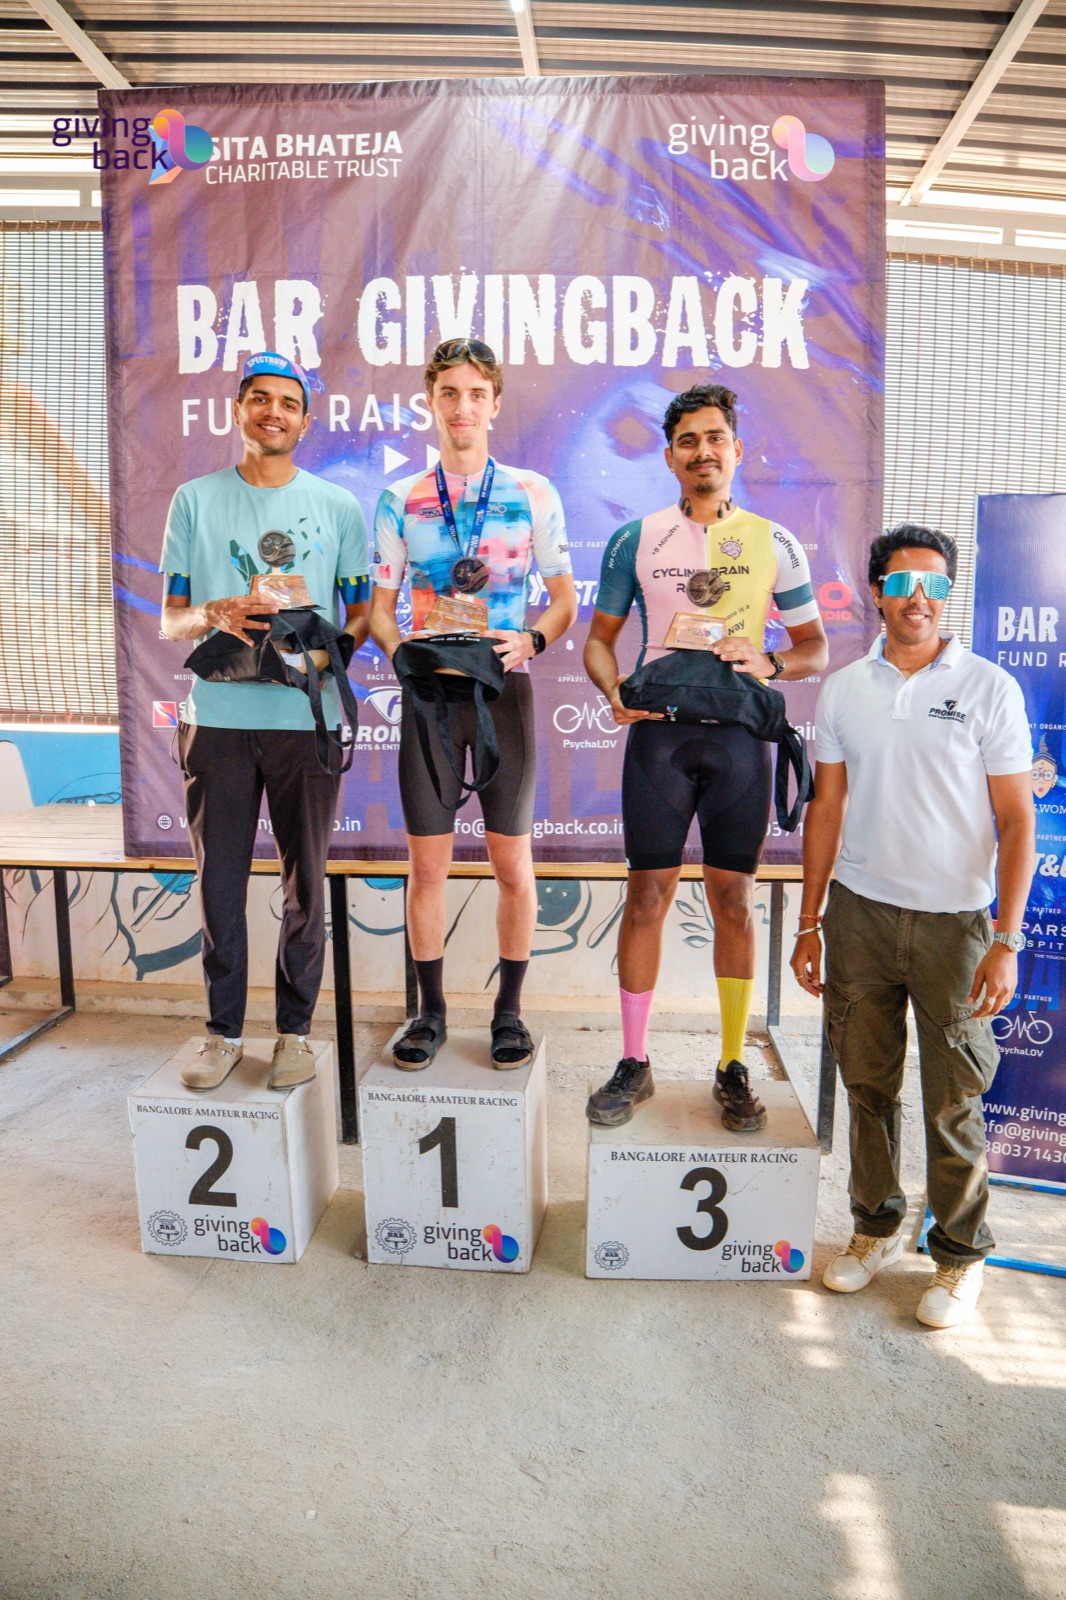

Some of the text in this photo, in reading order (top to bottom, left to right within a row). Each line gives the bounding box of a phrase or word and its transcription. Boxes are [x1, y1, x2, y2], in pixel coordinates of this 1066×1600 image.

[208, 131, 403, 161] SITA BHATEJA
[668, 116, 770, 155] giving
[205, 158, 402, 185] CHARITABLE TRUST
[710, 150, 789, 181] back
[176, 270, 810, 374] BAR GIVINGBACK
[658, 524, 680, 548] Minutes
[773, 531, 800, 569] Coffee!!!
[652, 568, 698, 579] CYCLIN
[996, 606, 1059, 643] BAR
[997, 651, 1048, 667] FUND
[929, 707, 967, 721] PROMISE
[341, 725, 402, 743] PROM
[563, 739, 618, 750] PsychaLOV
[1032, 906, 1061, 914] PARTNER
[1024, 994, 1053, 1002] PARTNER
[368, 1092, 518, 1107] BANGALORE AMATEUR RACING
[136, 1104, 279, 1120] BANGALORE AMATEUR RACING
[185, 1125, 237, 1207] 2
[419, 1116, 459, 1208] 1
[611, 1151, 798, 1164] BANGALORE AMATEUR RACING
[676, 1167, 728, 1251] 3
[194, 1214, 251, 1239] giving
[424, 1222, 482, 1247] giving
[218, 1234, 262, 1254] back
[448, 1242, 493, 1262] back
[721, 1240, 774, 1261] giving
[742, 1258, 782, 1274] back
